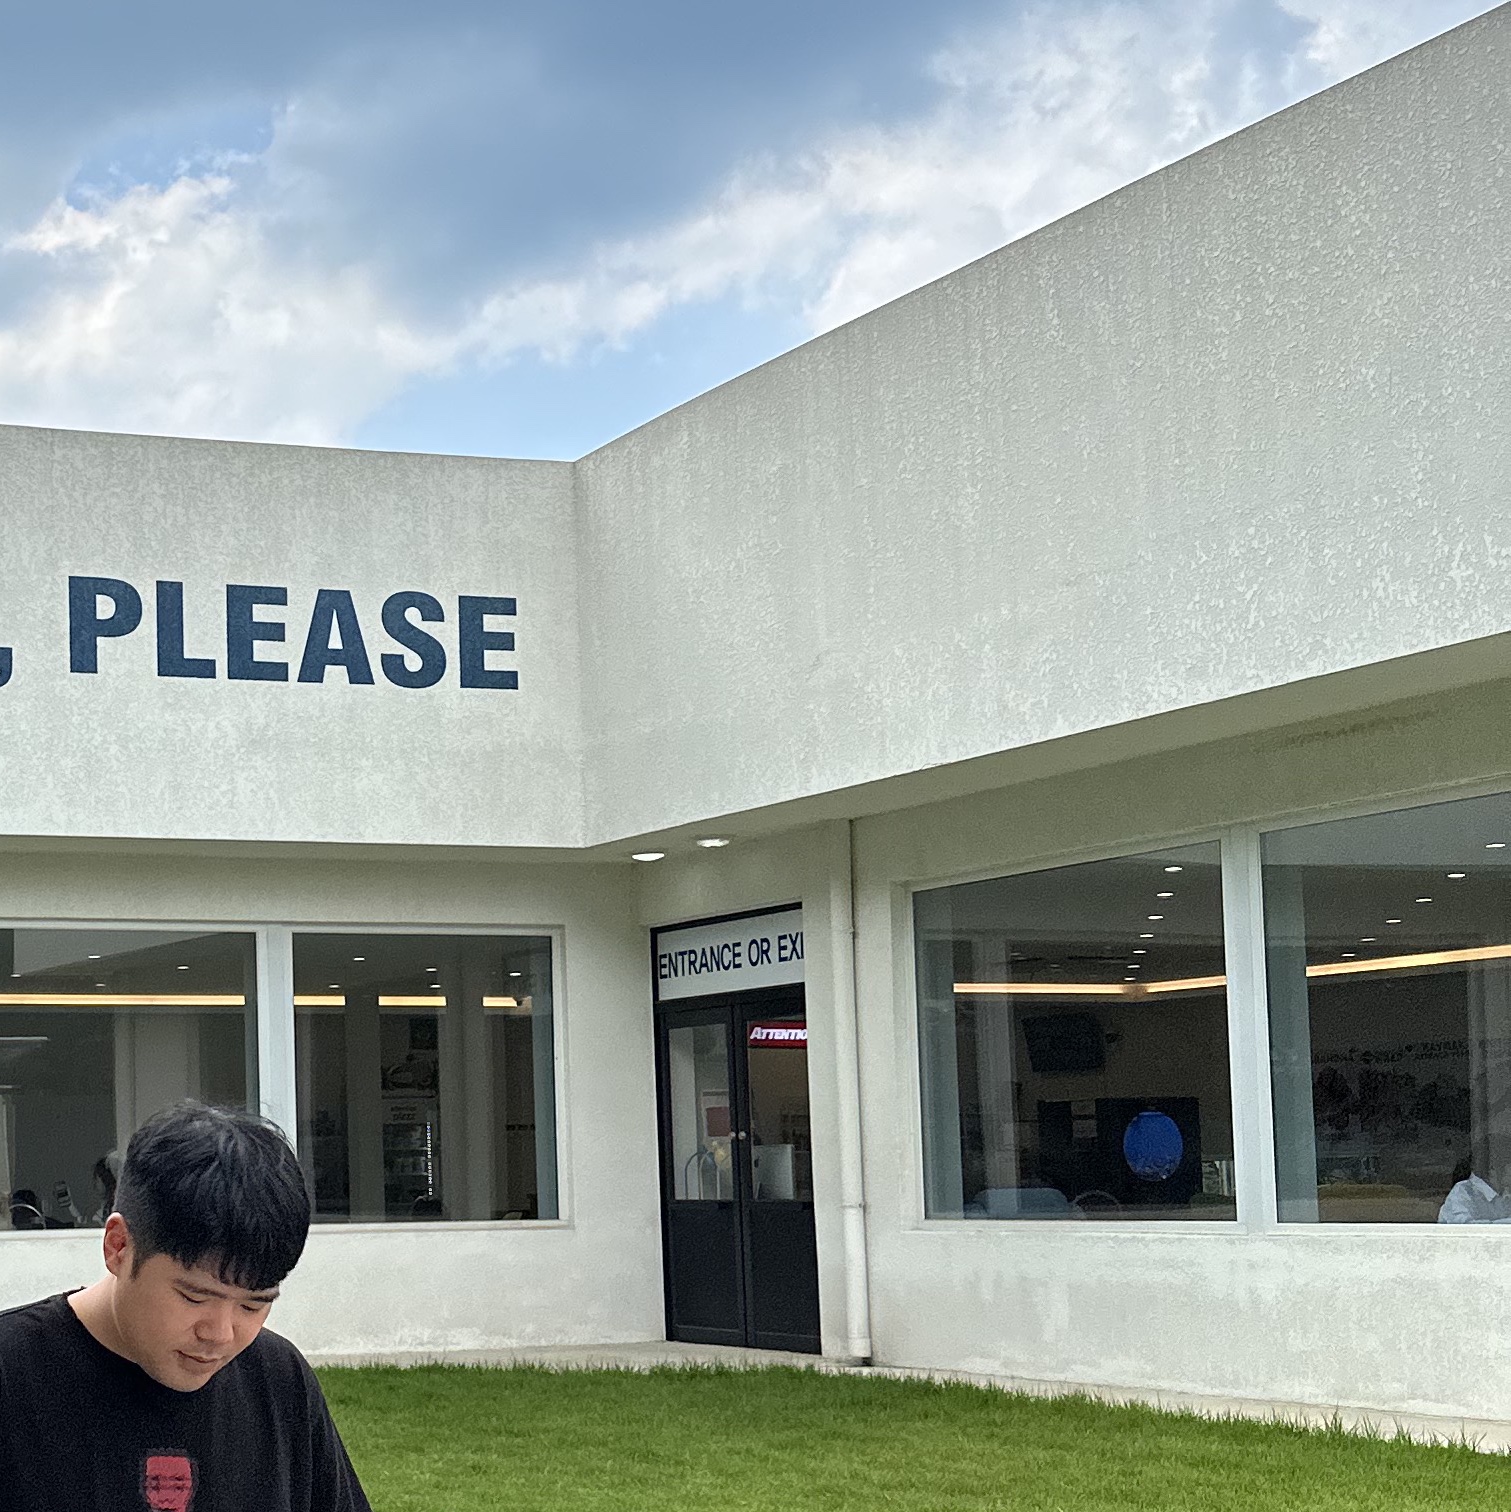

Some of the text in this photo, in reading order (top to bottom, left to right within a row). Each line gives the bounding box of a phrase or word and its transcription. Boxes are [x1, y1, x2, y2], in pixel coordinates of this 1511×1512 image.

[68, 575, 519, 690] PLEASE
[658, 941, 742, 979] ENTRANCE
[748, 937, 772, 967] OR
